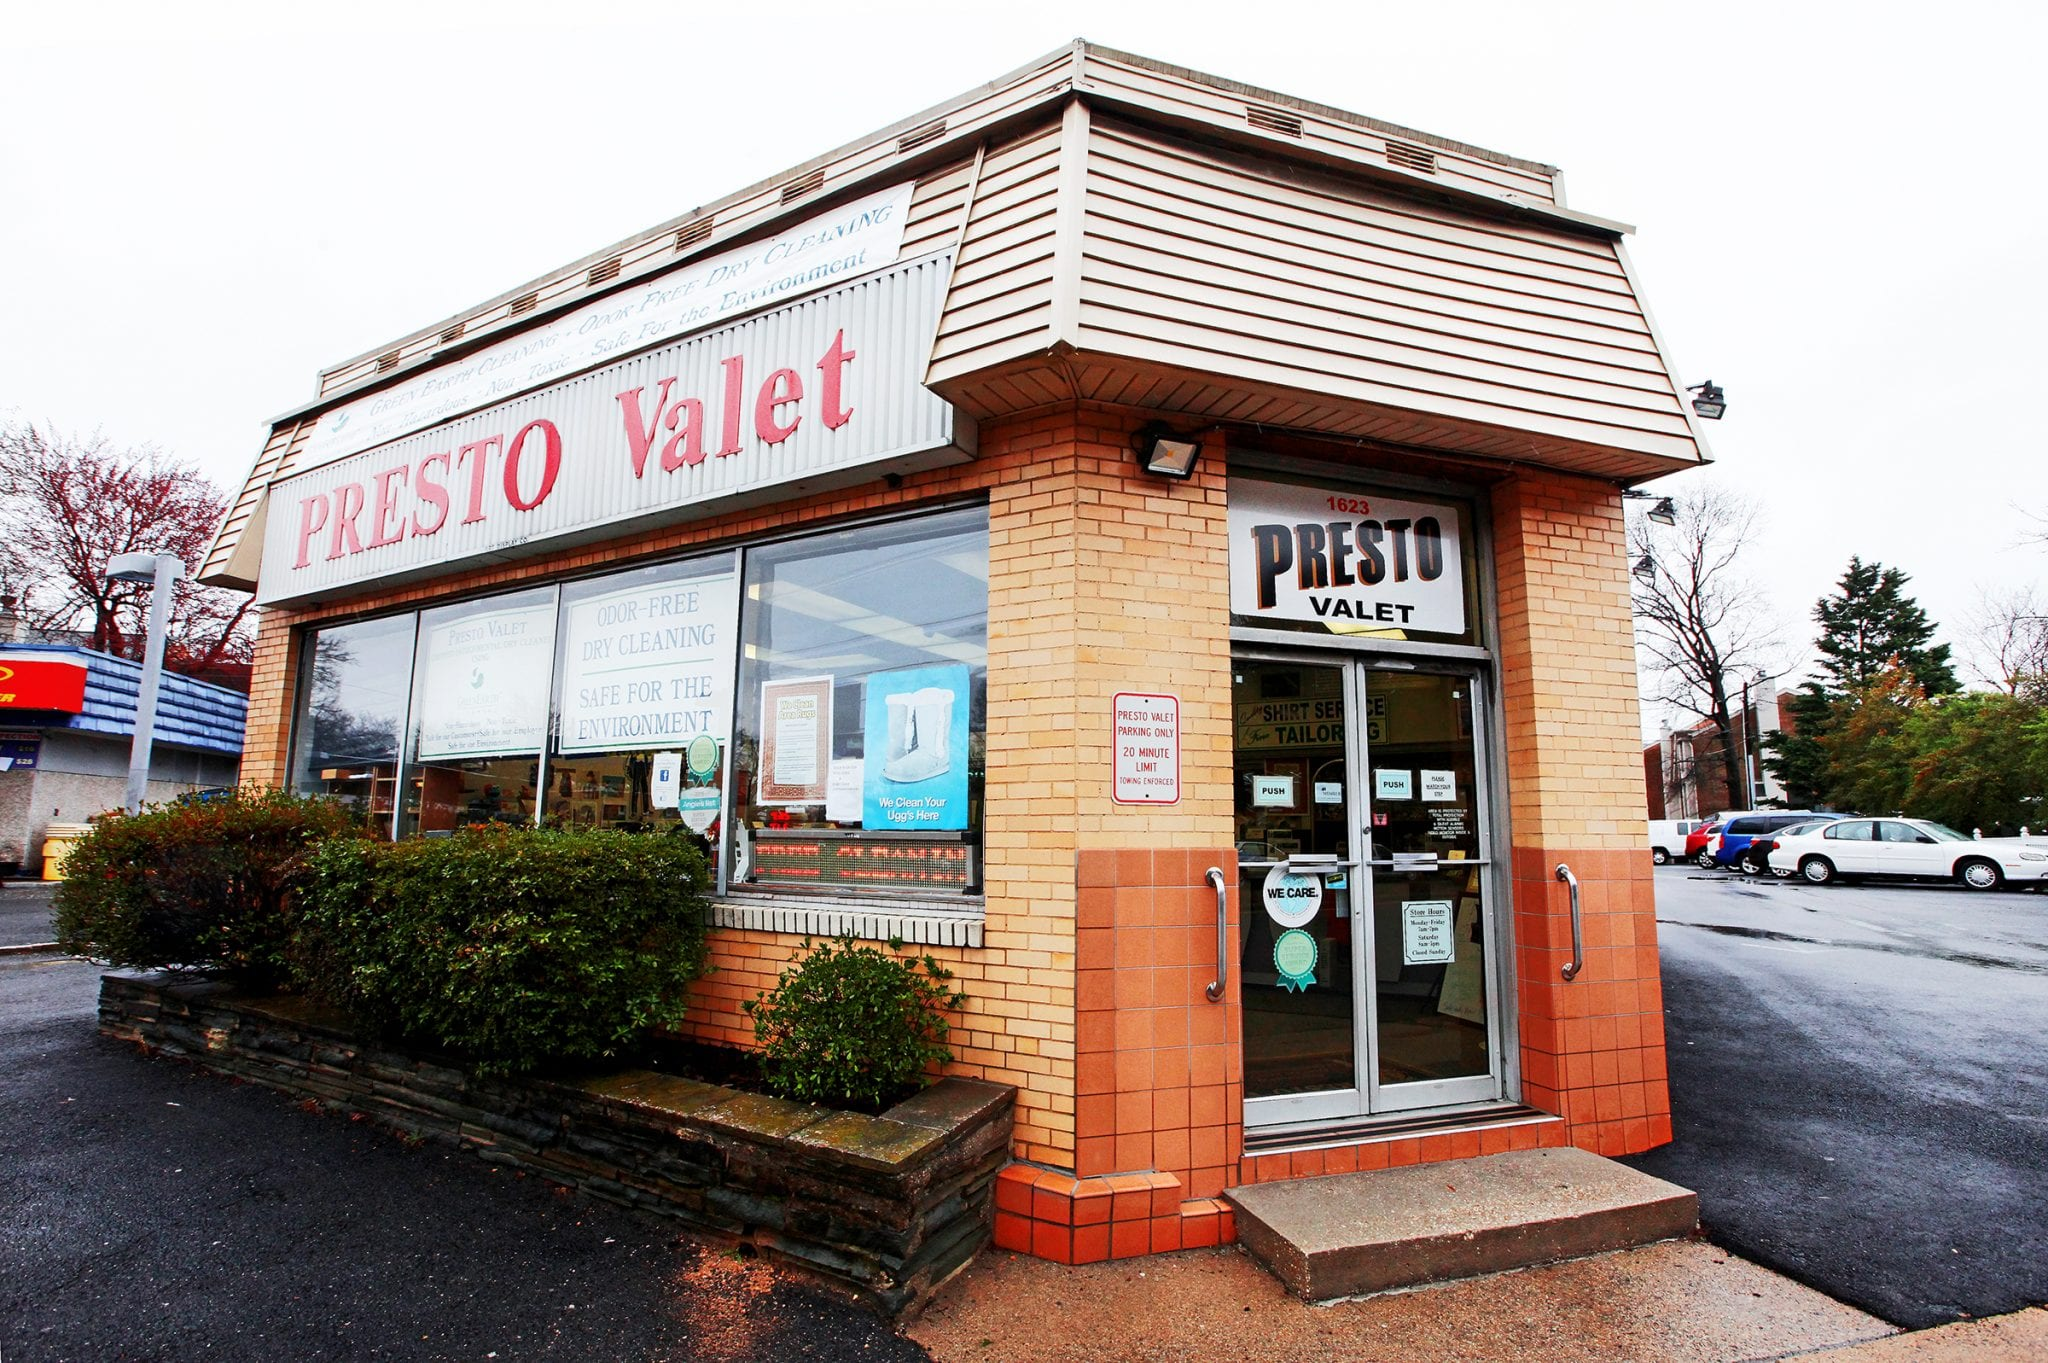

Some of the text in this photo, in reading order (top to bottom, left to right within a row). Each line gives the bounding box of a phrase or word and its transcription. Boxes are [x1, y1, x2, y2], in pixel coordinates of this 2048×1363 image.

[369, 205, 893, 416] GREEN EARTH CLEANING ODOR FREE DRY CLEANING
[527, 354, 570, 380] Toxic
[591, 330, 630, 356] Safe
[637, 319, 673, 340] For
[679, 304, 710, 325] the
[718, 247, 867, 313] Environment
[292, 328, 856, 570] PRESTO Valet
[1326, 495, 1370, 516] 1623
[1250, 516, 1444, 610] PRESTO
[596, 591, 699, 627] ODOR-FREE
[1309, 596, 1415, 624] VALET
[582, 623, 717, 662] DRY CLEANING
[579, 675, 713, 709] SAFE FOR THE
[1118, 710, 1174, 722] PRESTO VALET
[1263, 701, 1310, 722] SHIRT
[1315, 697, 1385, 720] SERCE
[577, 710, 713, 741] ENVIRONMENT
[1118, 726, 1175, 738] PARKING ONLY
[1275, 721, 1380, 744] TAILORG
[1123, 746, 1170, 758] 20 MINUTE
[1136, 761, 1157, 772] LIMIT
[1120, 776, 1174, 786] TOWING ENFORCED
[1262, 786, 1286, 796] PUSH
[1383, 780, 1404, 789] PUSH
[879, 796, 948, 808] We Clean Your
[887, 809, 939, 823] Ugg's Here
[1267, 887, 1285, 899] WE
